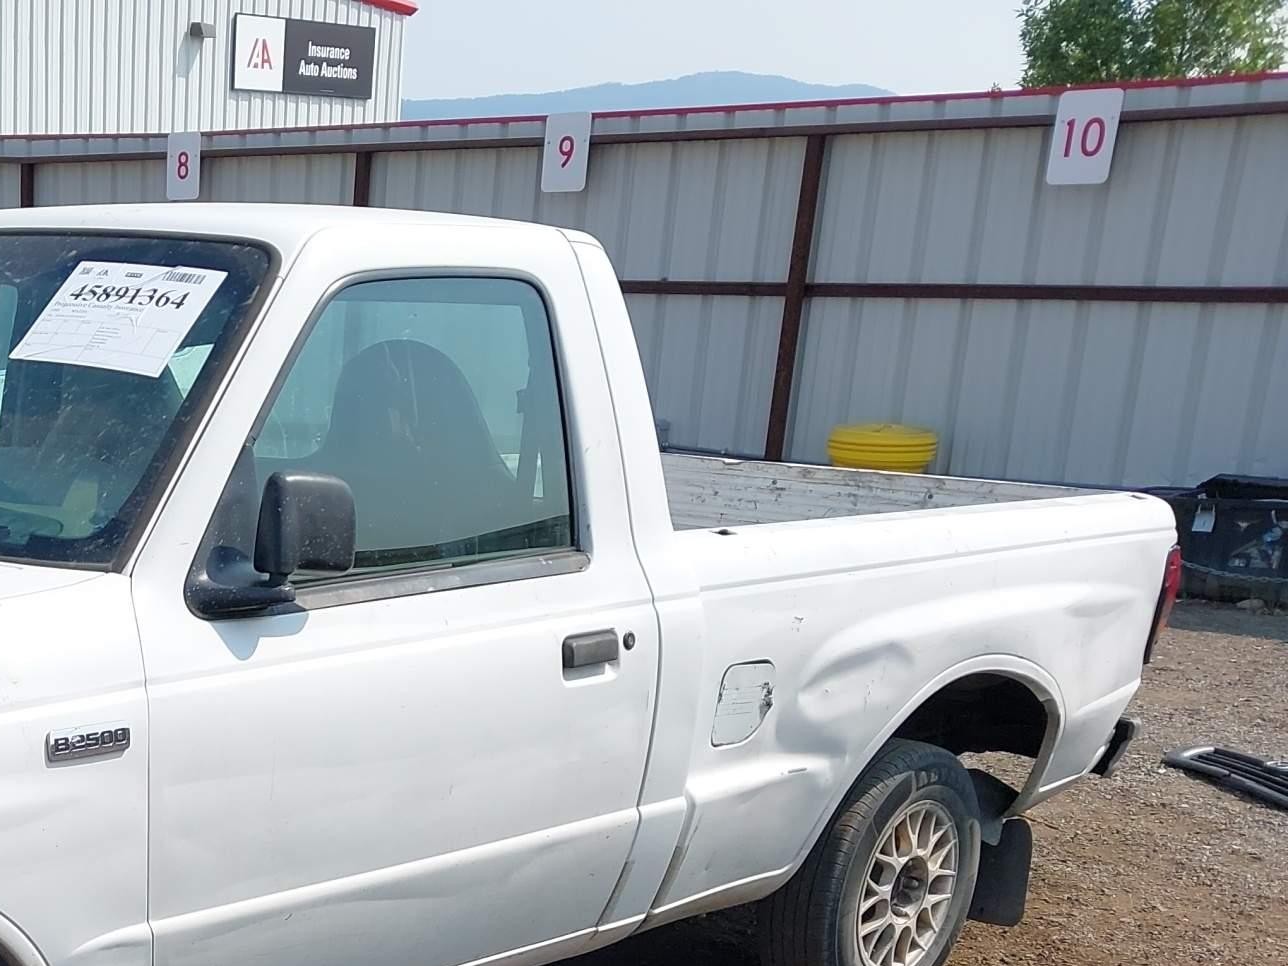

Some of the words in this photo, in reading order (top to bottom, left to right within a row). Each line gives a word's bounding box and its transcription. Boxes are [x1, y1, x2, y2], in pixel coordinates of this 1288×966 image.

[308, 40, 351, 60] Insurance
[298, 59, 320, 77] Auto
[320, 61, 358, 80] Auctions
[1064, 117, 1106, 158] 10
[177, 151, 189, 180] 8
[559, 135, 575, 169] 9
[69, 282, 191, 310] 45891364
[53, 727, 131, 754] B2500
